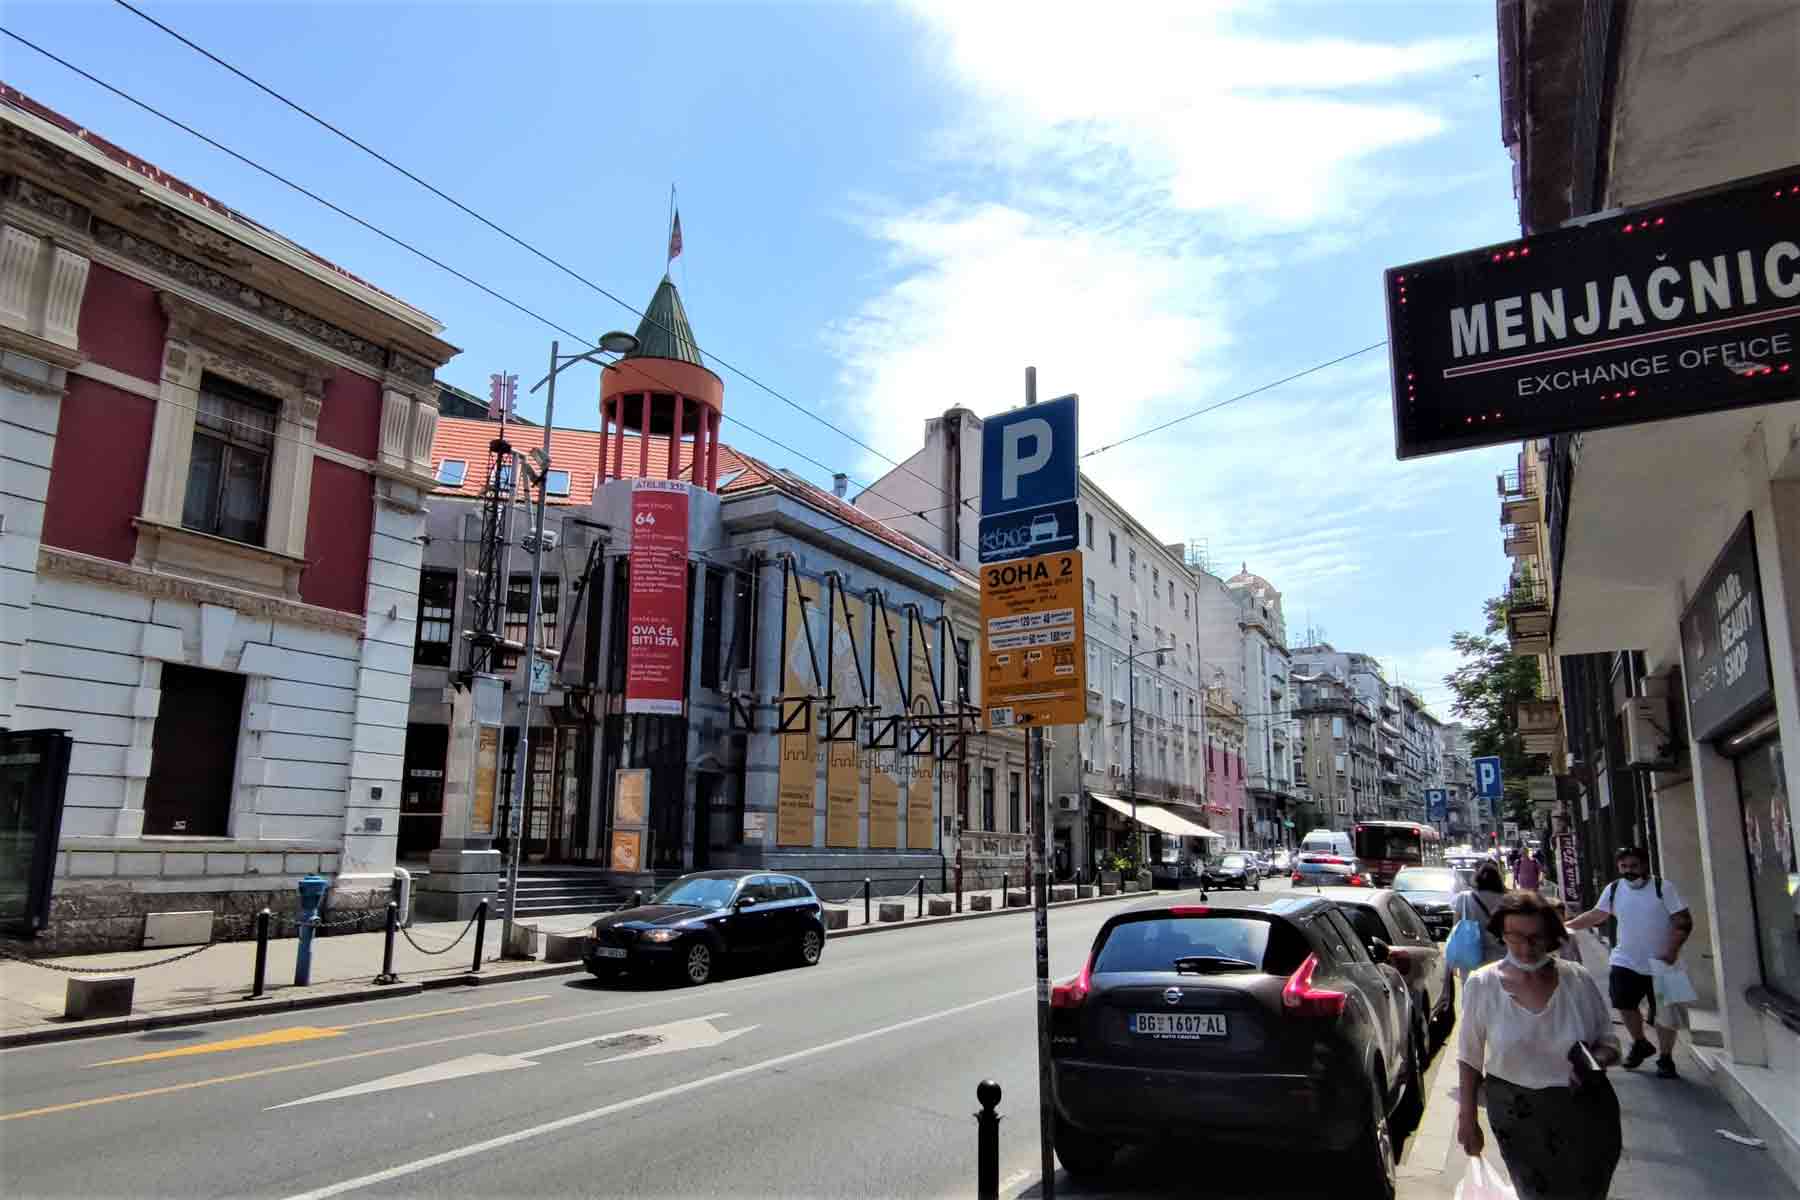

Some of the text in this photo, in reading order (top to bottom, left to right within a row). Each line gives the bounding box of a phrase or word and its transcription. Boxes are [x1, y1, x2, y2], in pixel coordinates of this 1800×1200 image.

[1517, 333, 1793, 396] EXCHANGE OFFICE
[1002, 418, 1052, 500] P
[635, 512, 656, 526] 64
[987, 561, 1049, 588] ЗОНА
[1060, 557, 1073, 576] 2
[632, 625, 656, 635] OVA
[1721, 592, 1752, 653] BEAUTY
[632, 636, 680, 648] BITI ISTA
[1725, 640, 1748, 687] SHOP
[1480, 763, 1495, 793] P
[1430, 791, 1442, 807] P
[1139, 1015, 1156, 1031] BG
